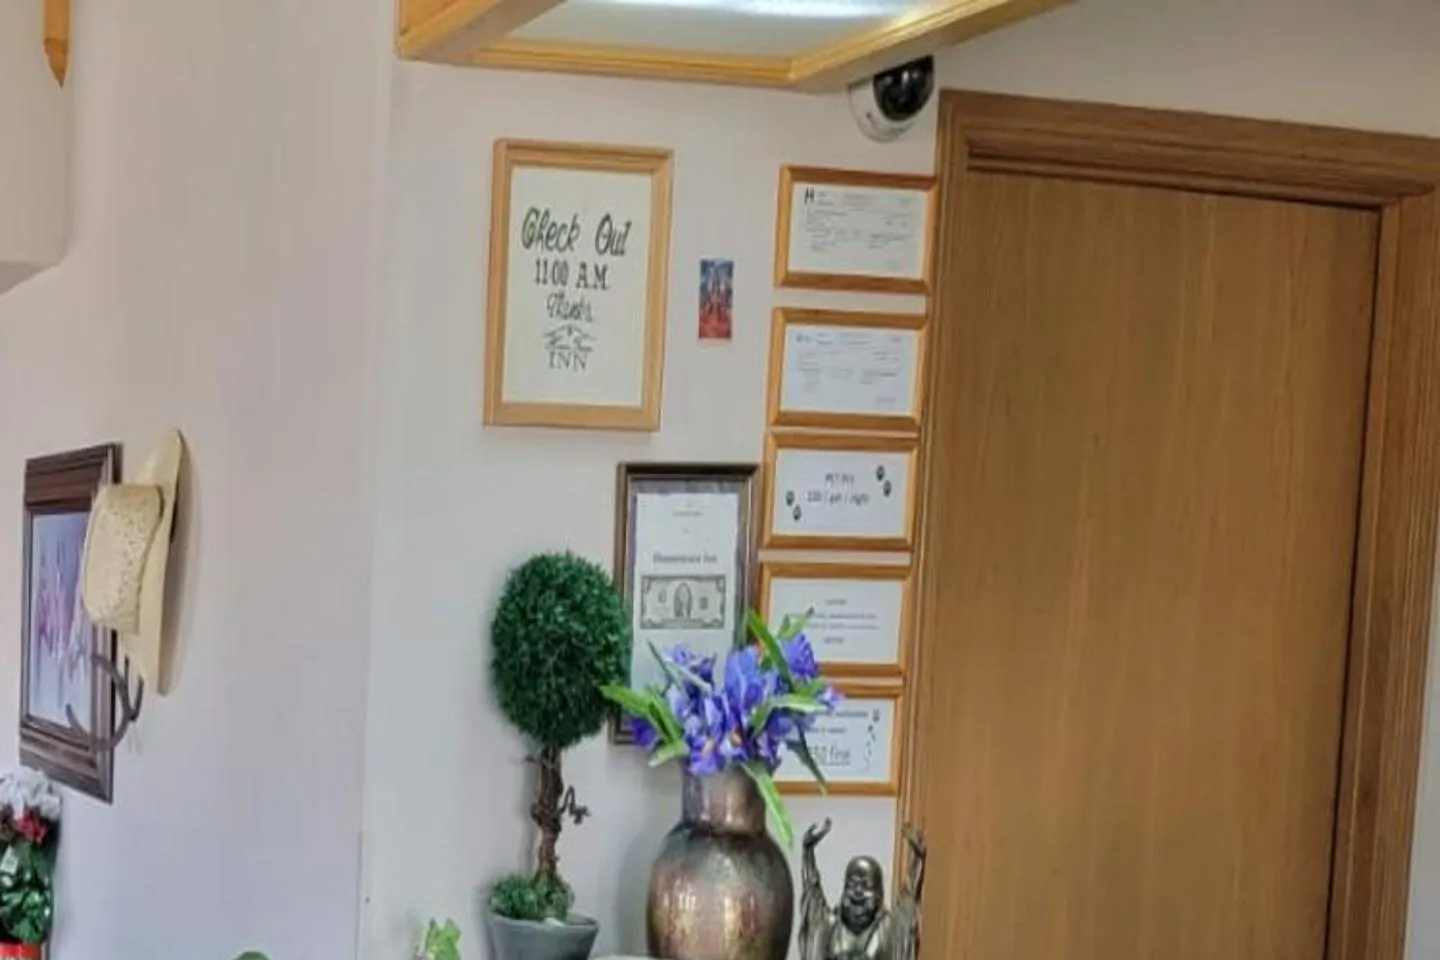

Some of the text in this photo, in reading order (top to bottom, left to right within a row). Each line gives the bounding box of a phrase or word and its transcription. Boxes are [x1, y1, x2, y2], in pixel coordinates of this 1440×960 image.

[521, 206, 632, 257] Check Out
[548, 350, 588, 372] INN
